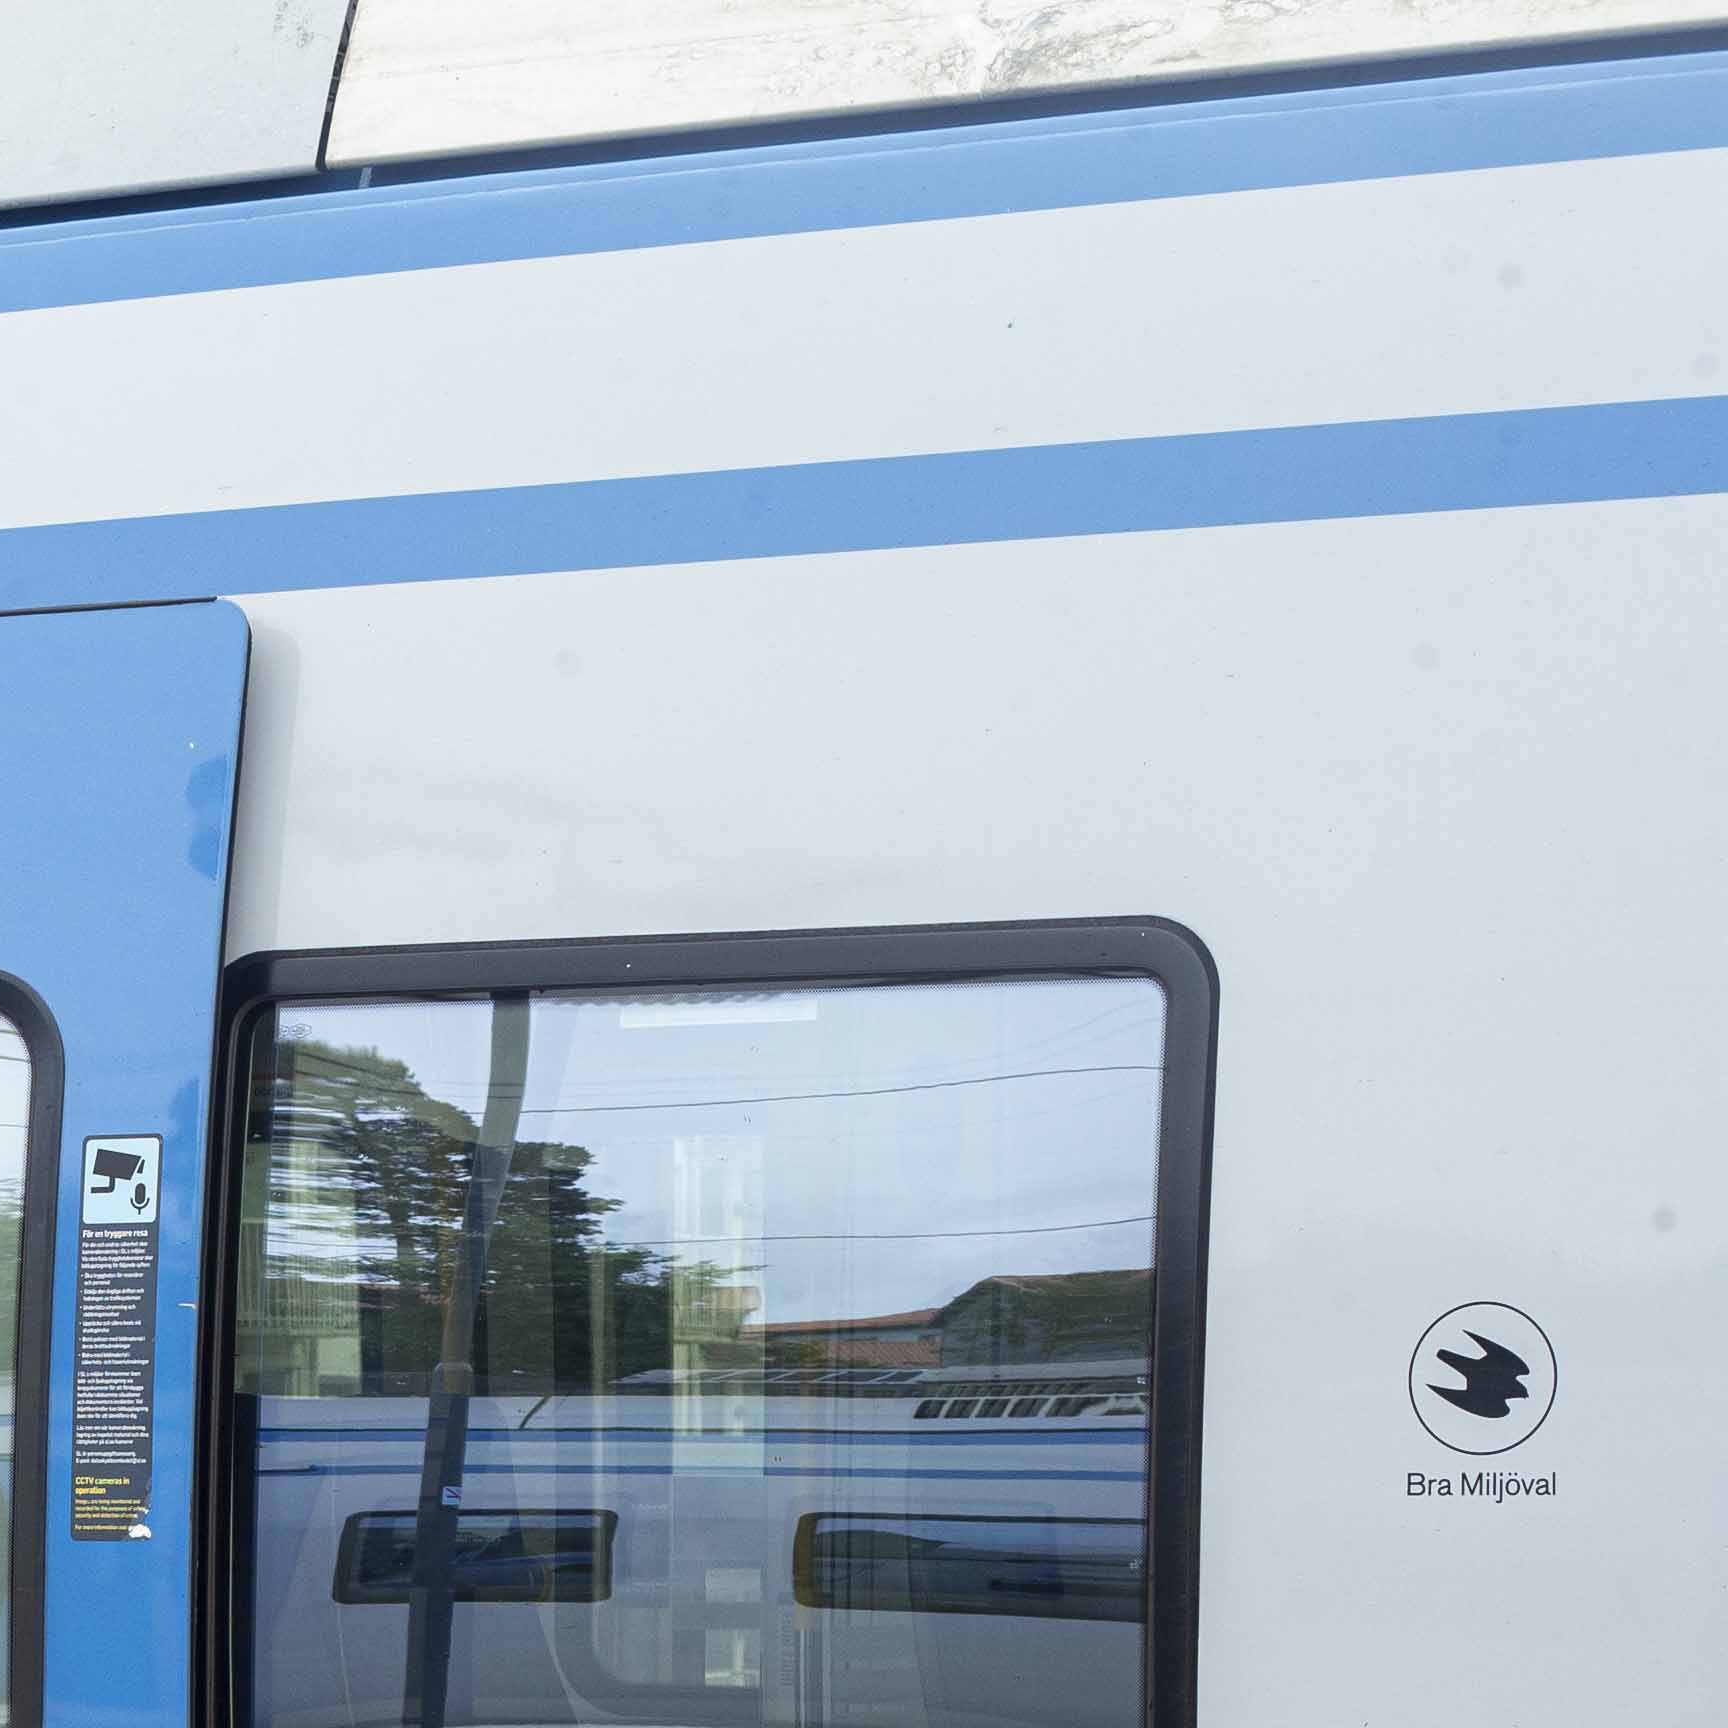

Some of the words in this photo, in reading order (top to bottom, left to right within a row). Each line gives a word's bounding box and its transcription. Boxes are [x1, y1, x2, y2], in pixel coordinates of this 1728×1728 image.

[75, 1476, 95, 1485] CCTV
[95, 1477, 122, 1486] cameras
[124, 1476, 131, 1486] in
[75, 1487, 107, 1497] operation
[1406, 1472, 1453, 1497] Bra
[1461, 1471, 1558, 1505] Miljöval
